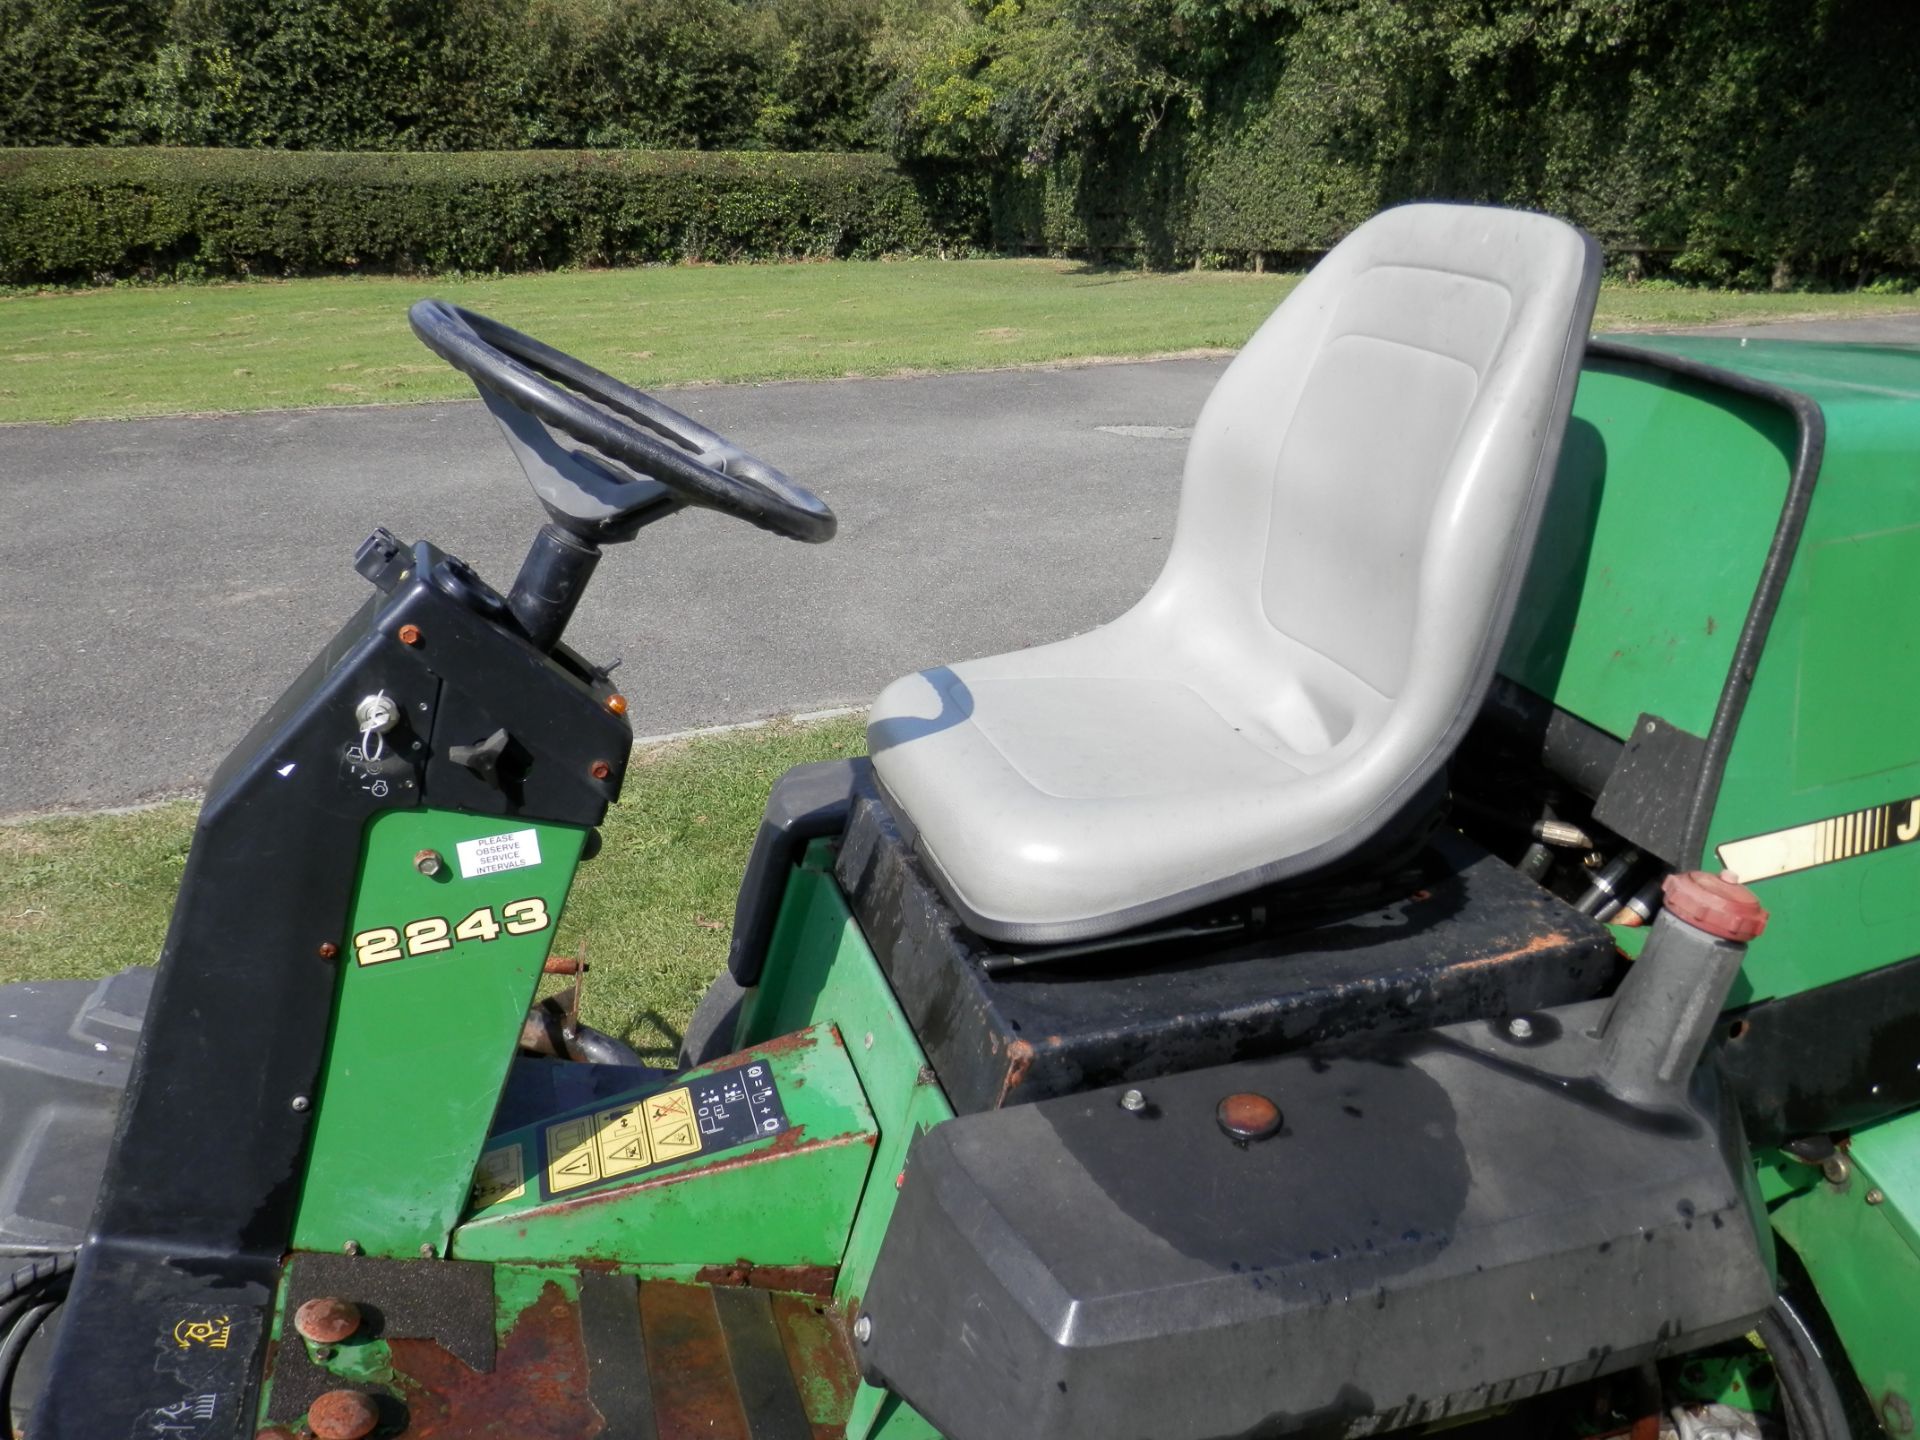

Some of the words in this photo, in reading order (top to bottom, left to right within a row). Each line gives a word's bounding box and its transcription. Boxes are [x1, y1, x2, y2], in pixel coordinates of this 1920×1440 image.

[478, 834, 514, 846] PLEASE
[475, 842, 520, 856] OBSERVE
[480, 851, 520, 865] SERVICE
[476, 859, 526, 874] INTERVALS
[353, 896, 550, 968] 2243
